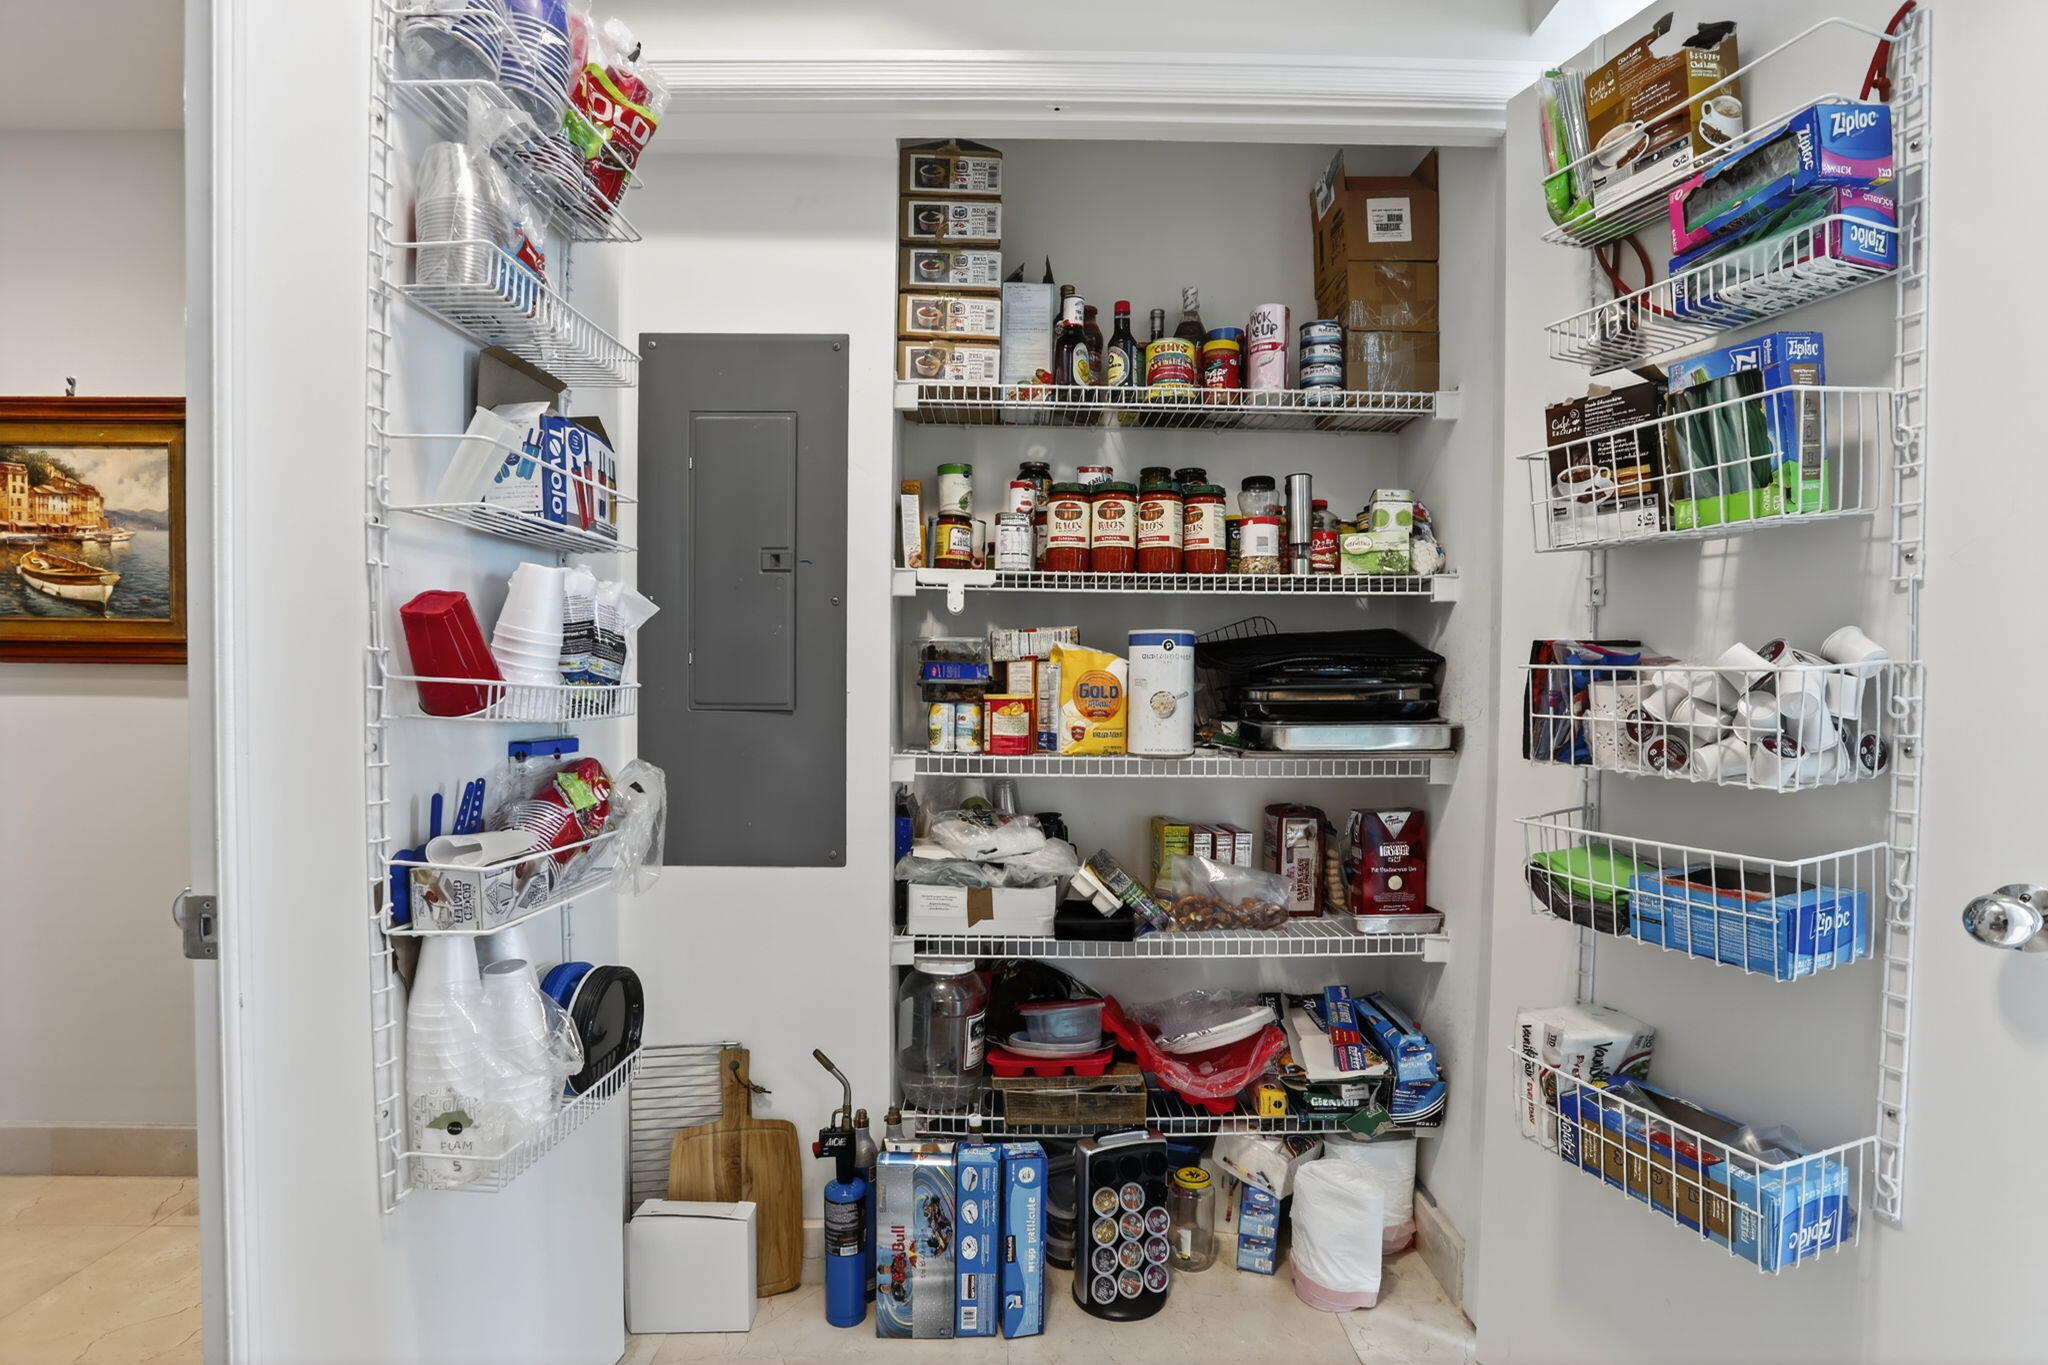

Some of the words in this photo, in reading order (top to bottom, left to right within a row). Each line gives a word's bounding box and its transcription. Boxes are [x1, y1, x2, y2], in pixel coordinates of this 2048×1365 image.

[1830, 109, 1878, 137] Ziploc
[1798, 123, 1814, 171] Ziploc
[1850, 225, 1887, 254] Ziploc
[1787, 339, 1819, 360] Ziploc
[549, 427, 567, 515] Tovolo
[1079, 682, 1119, 699] GOLD
[1816, 907, 1850, 936] Zipoc
[824, 1137, 847, 1147] ACE
[891, 1225, 905, 1252] Bull
